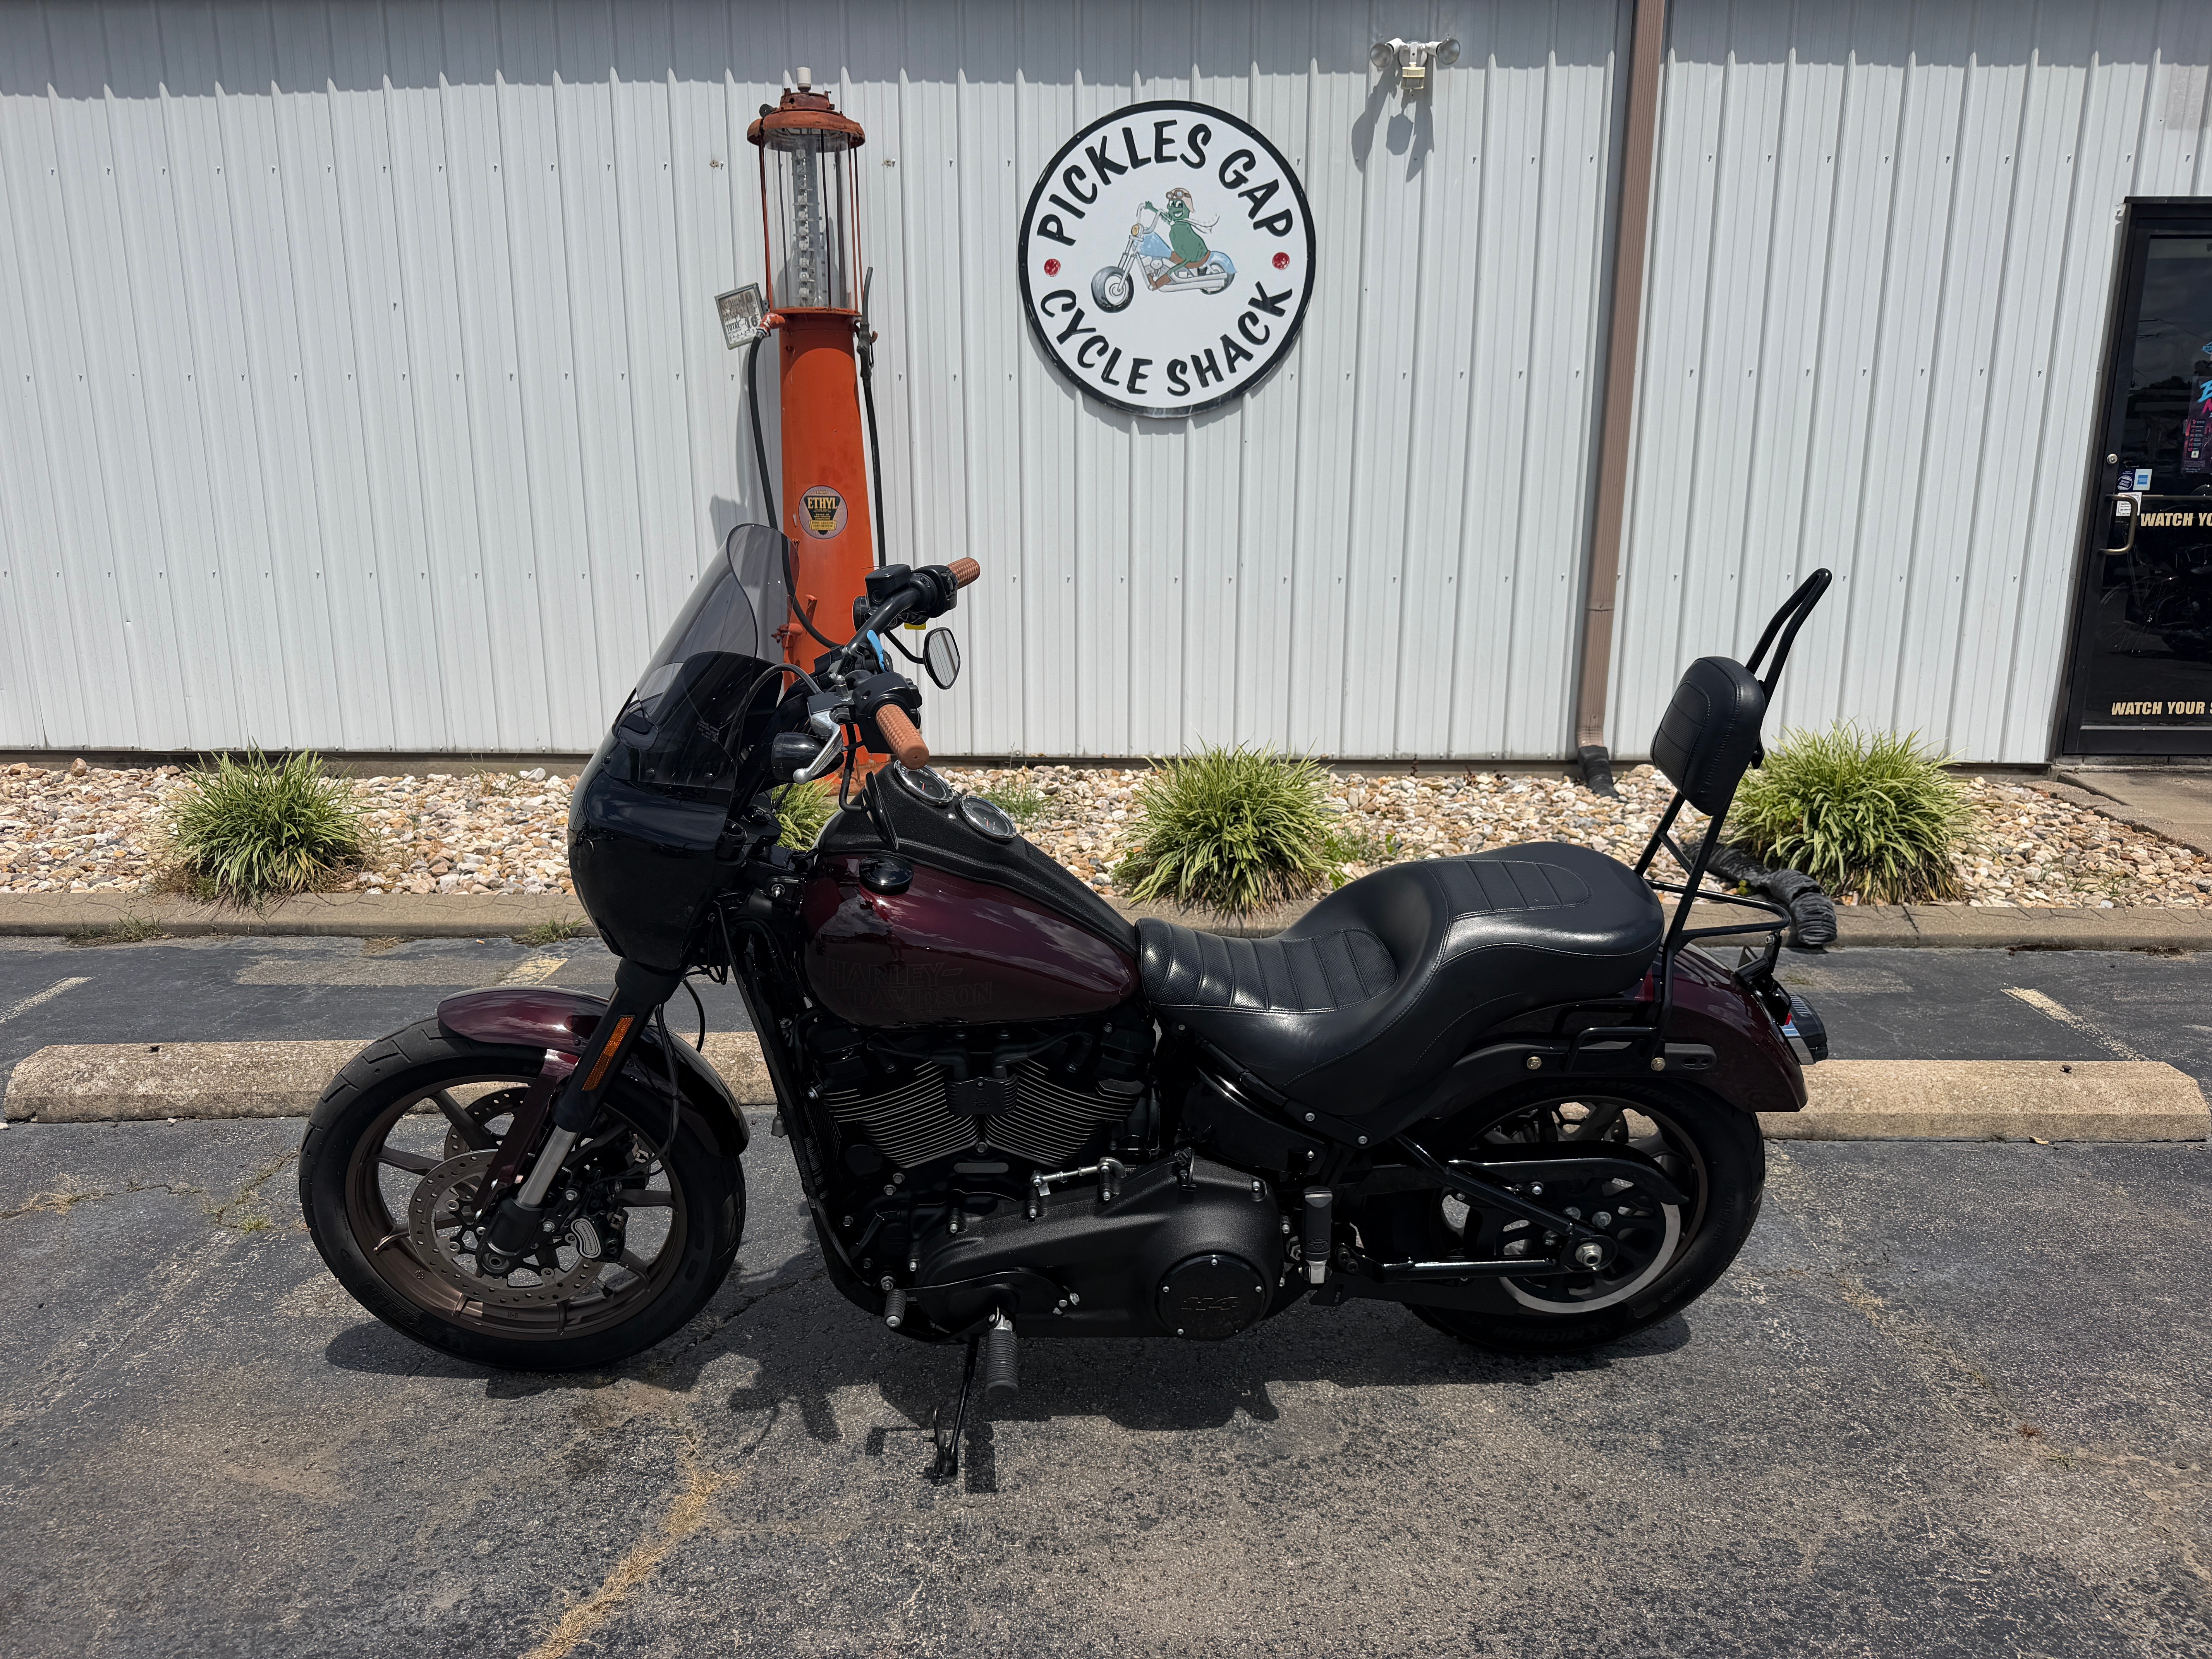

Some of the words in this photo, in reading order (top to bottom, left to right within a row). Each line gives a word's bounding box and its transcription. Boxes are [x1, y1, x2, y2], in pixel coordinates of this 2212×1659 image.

[1037, 120, 1212, 246] PICKLES
[1219, 149, 1293, 237] GAP
[1041, 290, 1152, 395] CYCLE
[1166, 281, 1292, 396] SHACK
[807, 497, 838, 509] ETHYL
[2141, 513, 2194, 526] WATCH
[2111, 701, 2162, 715] WATCH
[2167, 701, 2205, 714] YOUR
[826, 959, 964, 989] HARLEY-
[854, 981, 993, 1010] DAVIDSON
[1492, 1325, 1585, 1342] MICHELIN
